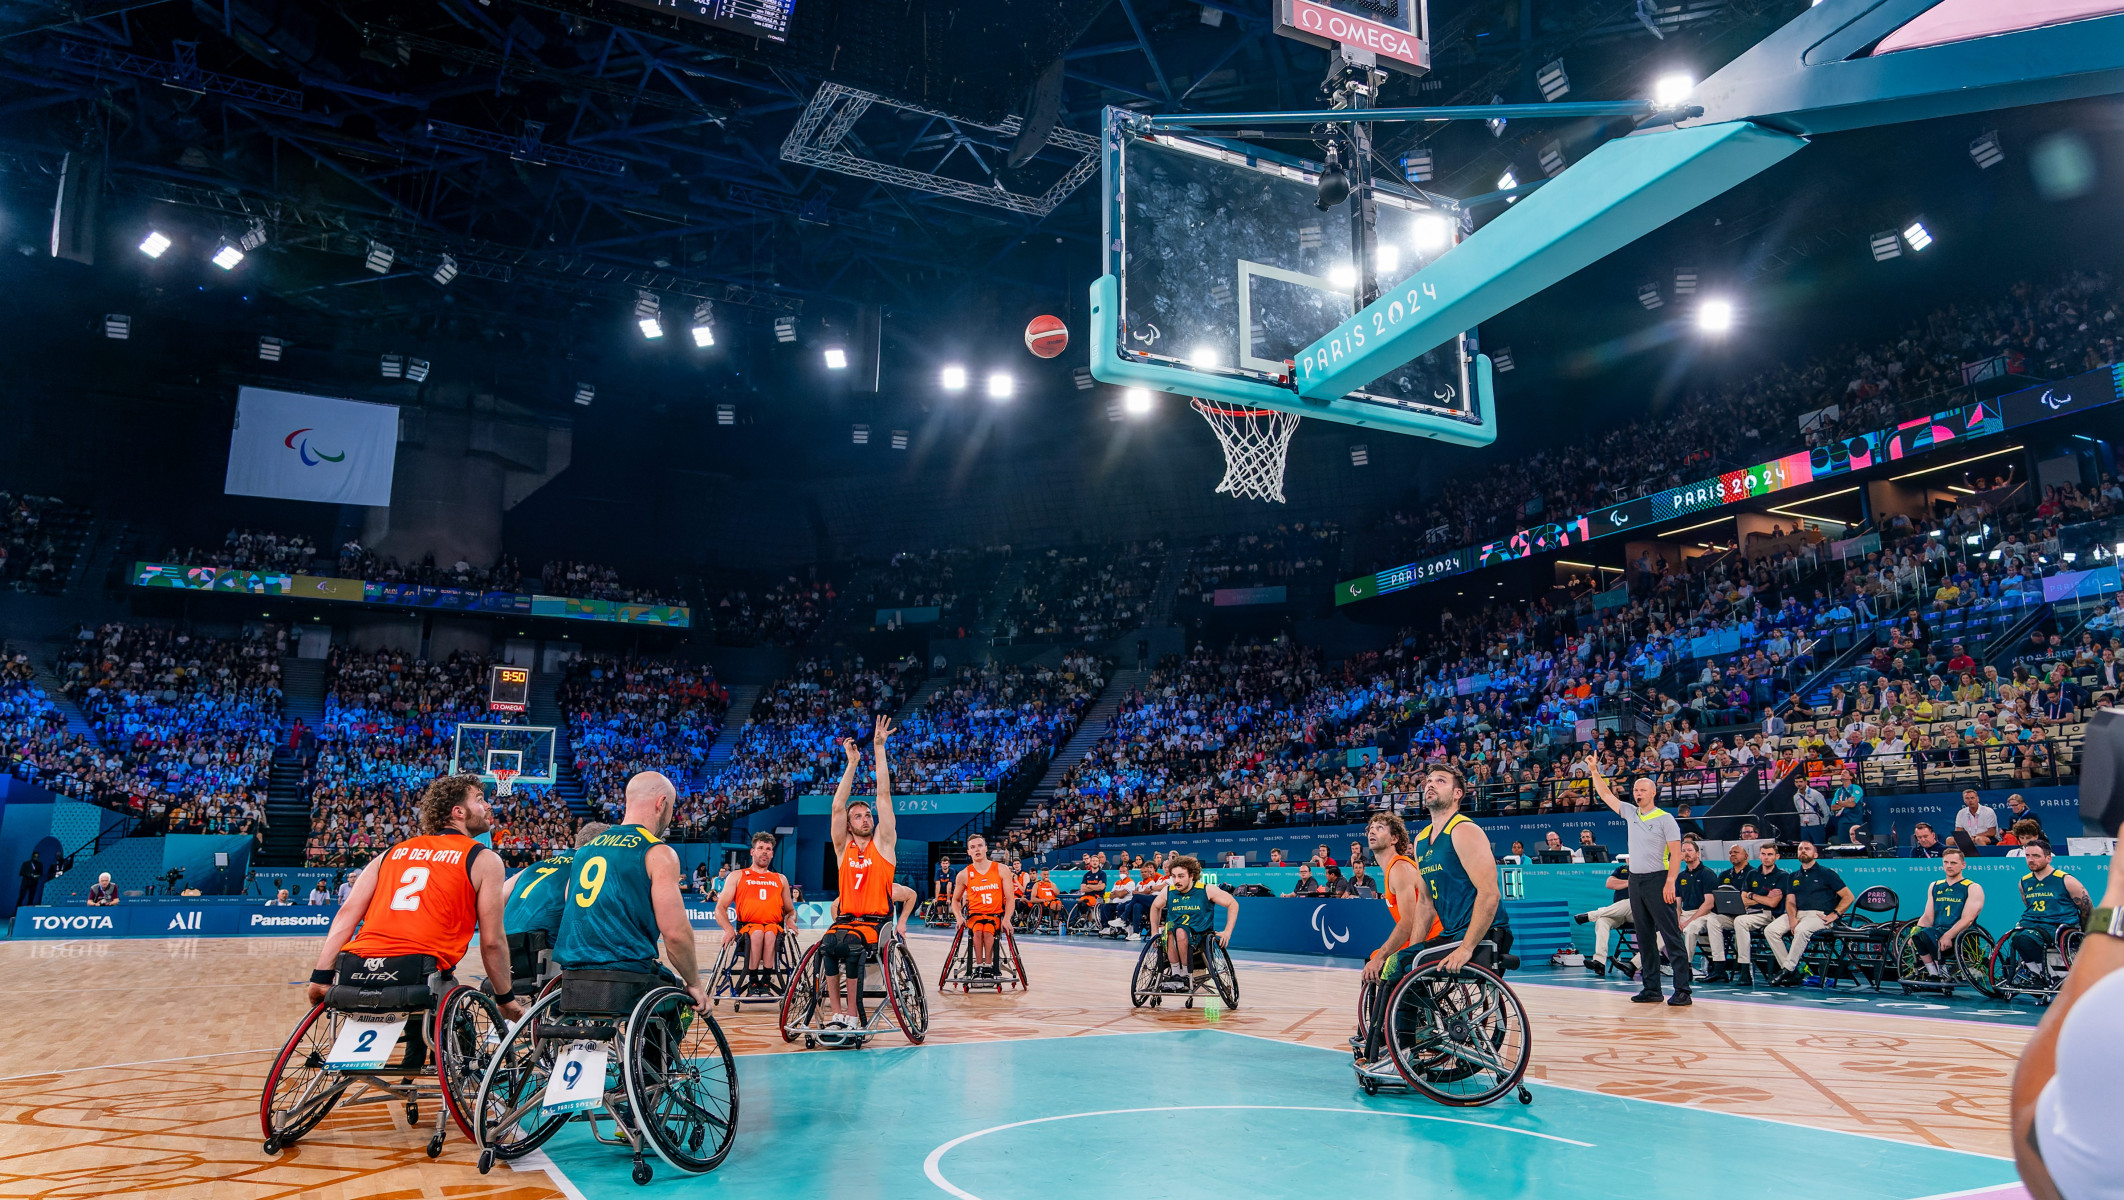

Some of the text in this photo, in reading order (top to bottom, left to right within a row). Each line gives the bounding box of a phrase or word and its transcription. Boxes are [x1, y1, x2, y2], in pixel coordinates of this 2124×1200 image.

[1328, 17, 1414, 60] OMEGA
[1303, 281, 1438, 379] PARIS 2024
[1673, 467, 1786, 510] PARIS 2024
[1391, 557, 1460, 586] PARIS 2024
[502, 671, 526, 683] 9:50
[899, 799, 938, 811] 2024
[391, 847, 409, 860] OP
[408, 847, 434, 861] DEN
[1419, 863, 1443, 876] USTRALIA
[519, 867, 559, 899] 7
[575, 855, 607, 908] 9
[745, 879, 779, 888] TeamNL
[854, 873, 864, 890] 7
[971, 883, 999, 892] TeamNL
[390, 866, 430, 912] 2
[759, 888, 767, 900] 0
[1430, 879, 1438, 900] 5
[2026, 891, 2054, 899] AUSTRALIA
[980, 893, 993, 905] 15
[2032, 900, 2046, 912] 13
[1944, 905, 1951, 917] 1
[32, 916, 114, 930] TOYOTA
[250, 913, 330, 926] Panasonic
[1182, 914, 1190, 926] 2
[363, 957, 388, 972] RGK
[357, 1013, 385, 1023] Allianz
[352, 1029, 378, 1053] 2
[563, 1060, 584, 1091] 9
